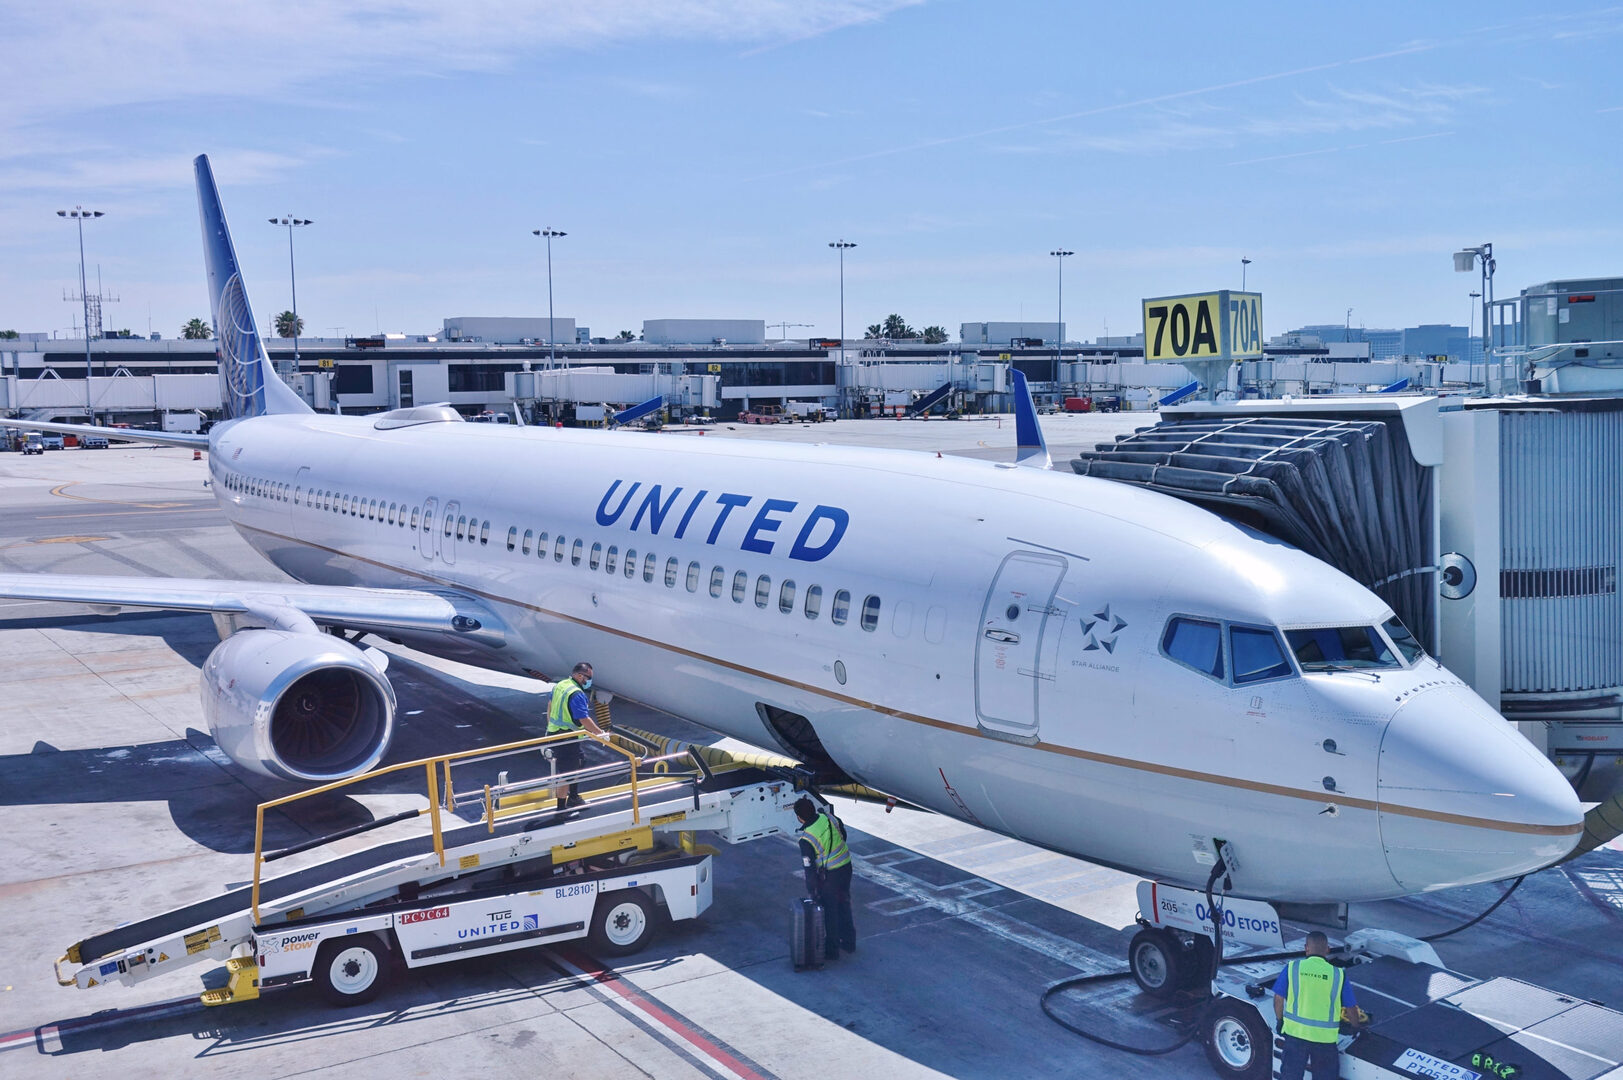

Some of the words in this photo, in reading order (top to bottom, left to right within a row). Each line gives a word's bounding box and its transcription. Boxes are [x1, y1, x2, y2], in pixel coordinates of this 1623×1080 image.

[1149, 300, 1218, 356] 70A
[1230, 299, 1261, 352] 70A
[595, 479, 850, 562] UNITED
[1088, 663, 1120, 673] ALLIANCE
[555, 884, 590, 899] BL2810
[1161, 901, 1178, 913] 205
[403, 908, 449, 924] PC9C64
[458, 921, 520, 939] UNITED
[1238, 917, 1278, 934] ETOPS
[281, 931, 321, 948] power
[283, 941, 313, 952] stow
[1406, 1050, 1460, 1075] UNITED
